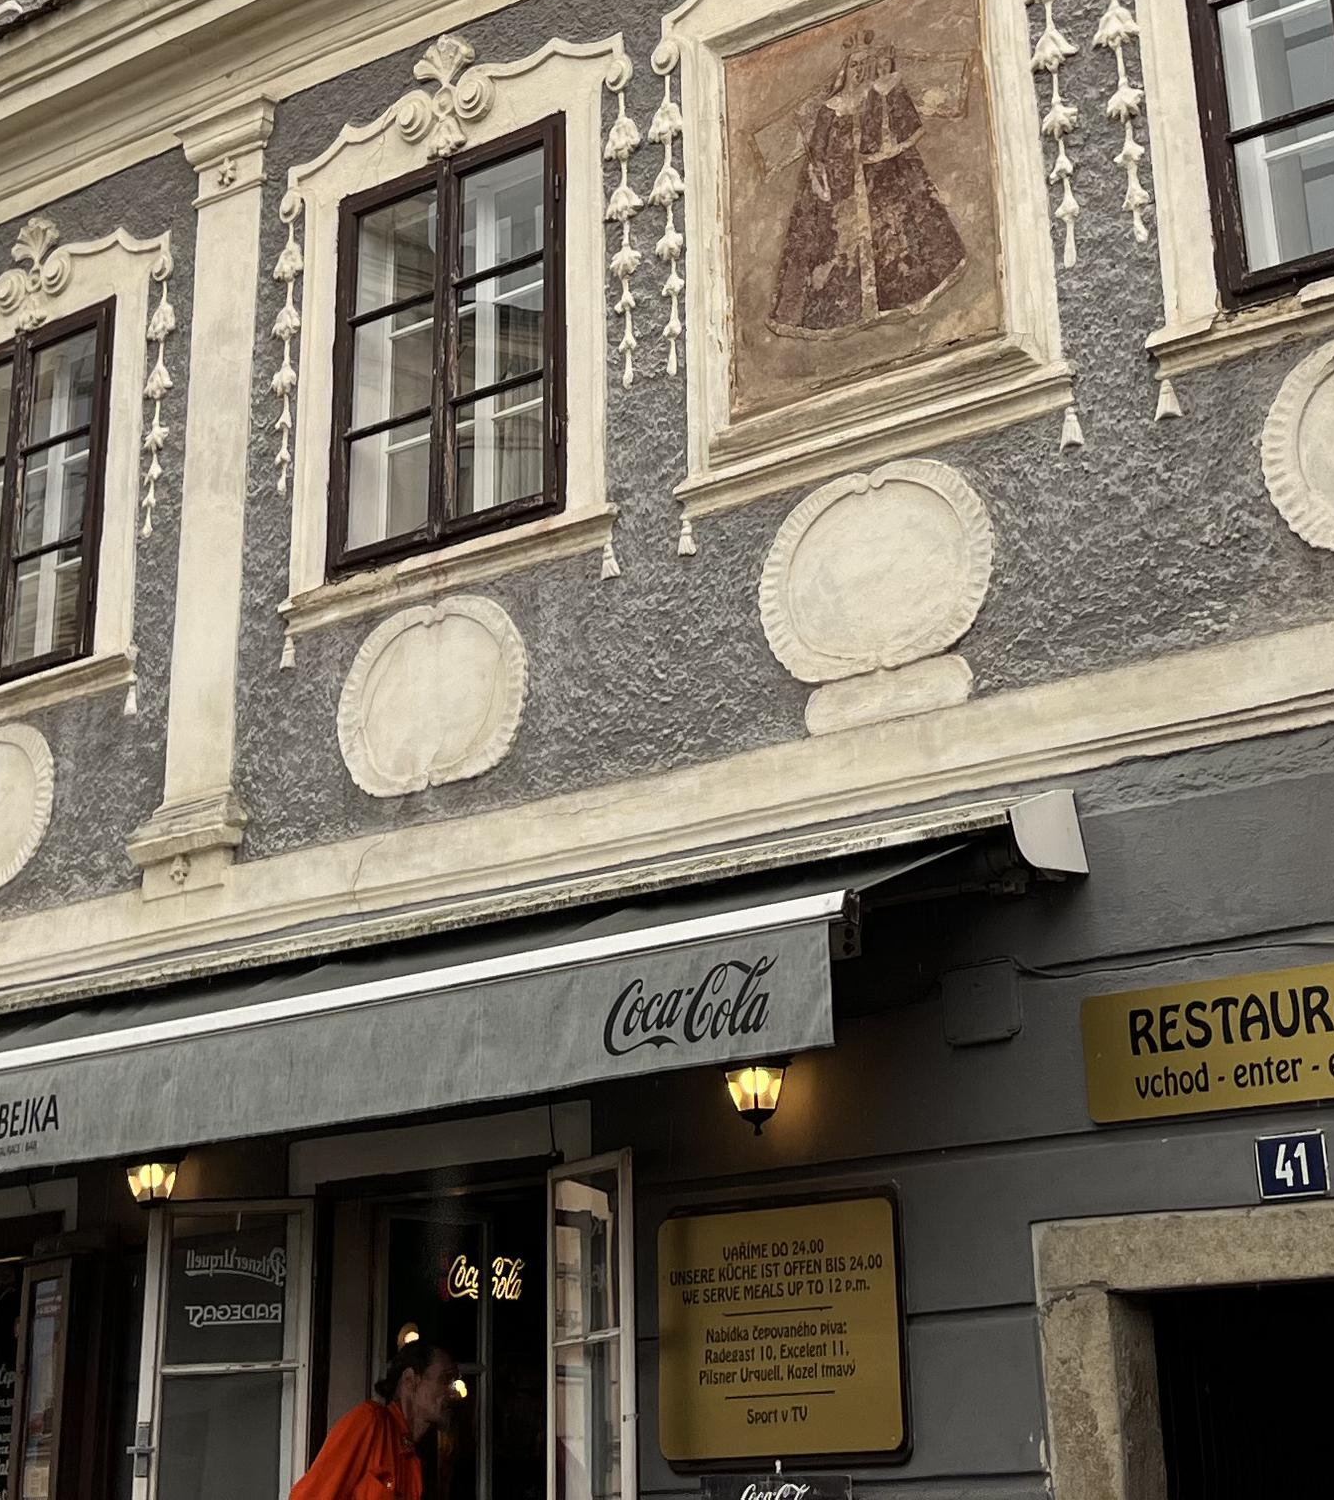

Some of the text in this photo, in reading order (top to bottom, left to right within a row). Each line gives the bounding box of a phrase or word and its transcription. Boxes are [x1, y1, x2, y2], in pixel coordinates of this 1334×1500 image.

[603, 954, 779, 1057] Coca-Cola
[1135, 1062, 1210, 1100] vchod
[1233, 1056, 1303, 1089] enter
[1273, 1142, 1310, 1188] 41
[722, 1238, 824, 1261] VAŘÍME DO 24.00
[669, 1253, 883, 1287] UNSERE KÜCHE IST OFFEN BIS 24.00
[682, 1277, 870, 1305] WE SERVE MEALS UP TO 12 p.m.
[706, 1319, 847, 1344] Nabídka čepovaného piva:
[705, 1346, 755, 1365] Radegast
[779, 1341, 827, 1360] Excelent
[699, 1368, 738, 1387] Pilsner
[787, 1362, 818, 1381] Kozel
[820, 1358, 856, 1378] tmavý
[746, 1405, 808, 1425] Sport v TV
